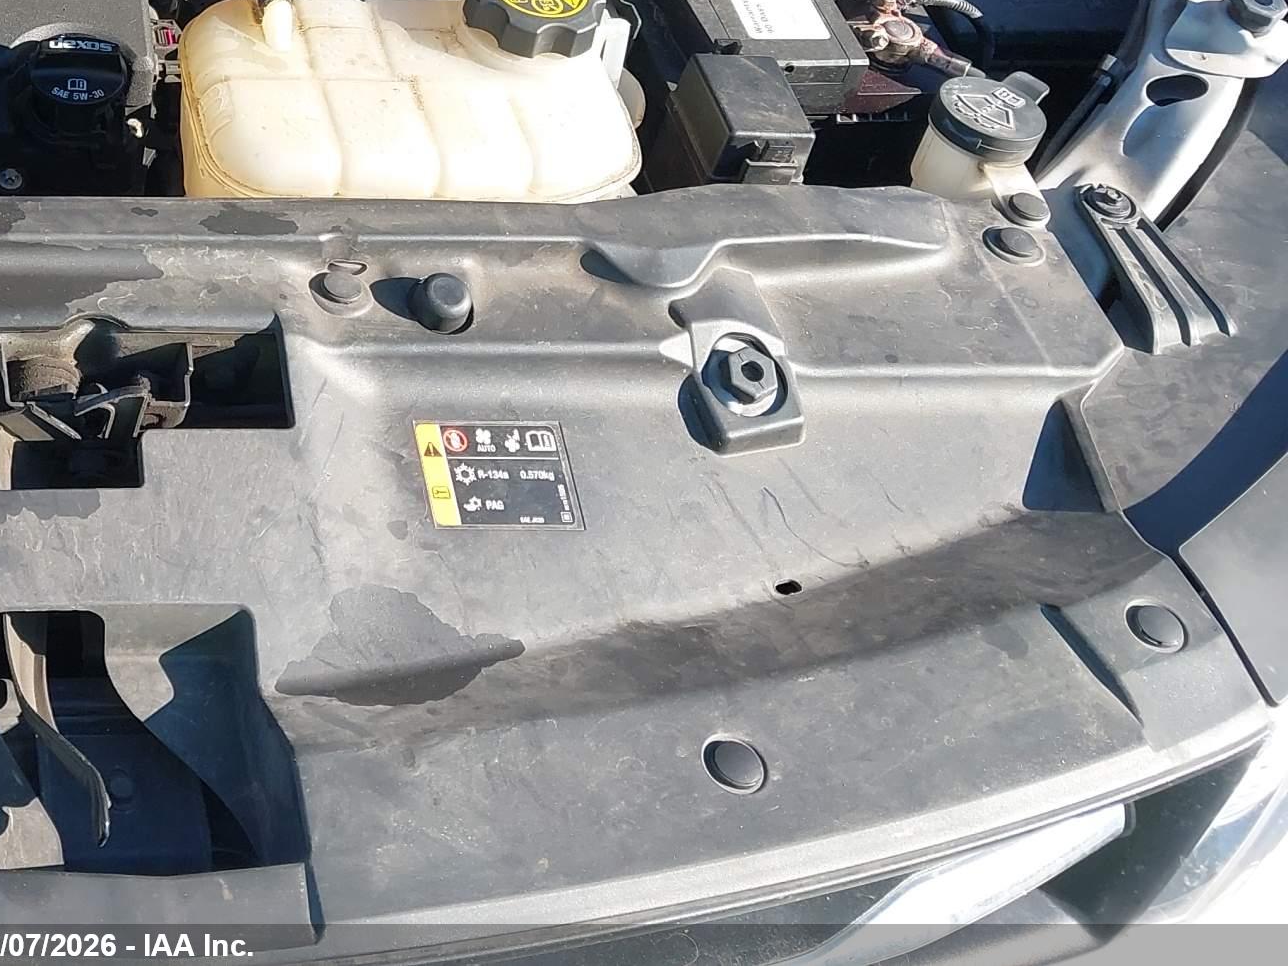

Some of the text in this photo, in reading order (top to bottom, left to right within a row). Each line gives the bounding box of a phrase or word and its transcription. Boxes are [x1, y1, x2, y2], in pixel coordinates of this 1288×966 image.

[49, 36, 114, 52] dexos
[52, 87, 105, 101] SAE 5W-30
[477, 444, 496, 452] AUTO
[477, 469, 555, 481] R-134a 0.570kg
[485, 499, 505, 510] PAG
